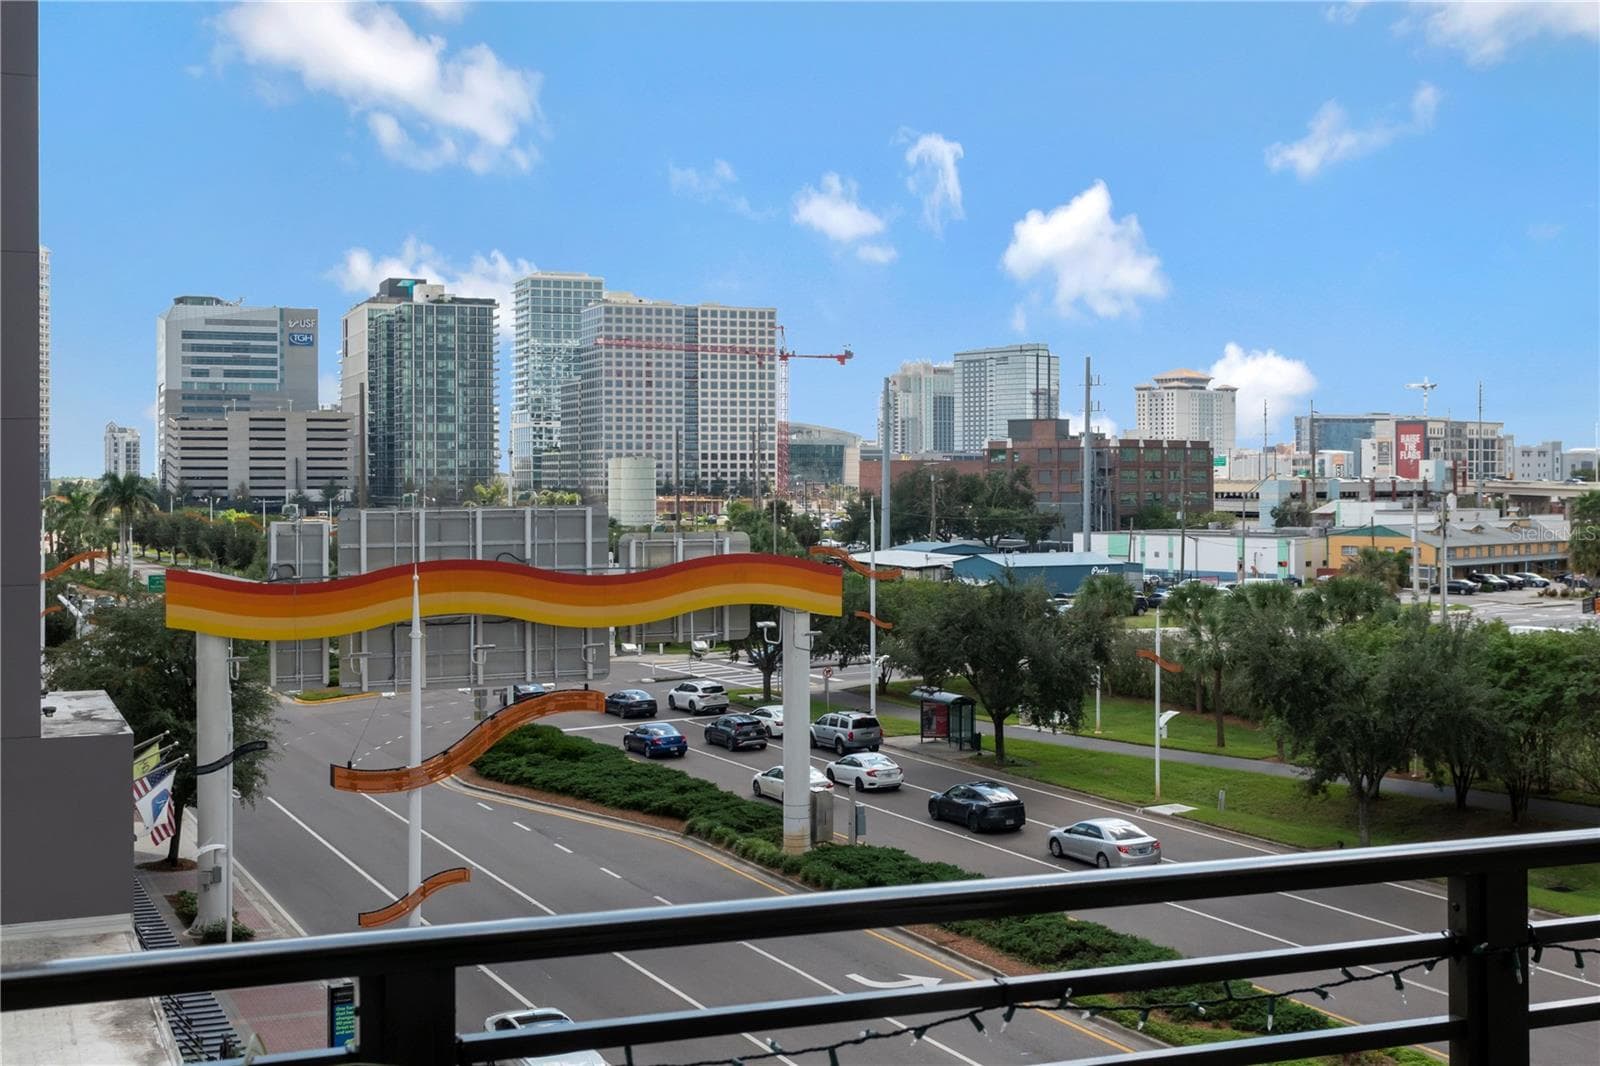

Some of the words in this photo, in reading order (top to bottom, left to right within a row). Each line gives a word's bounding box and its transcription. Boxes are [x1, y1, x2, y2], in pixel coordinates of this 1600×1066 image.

[300, 319, 316, 328] USF
[292, 334, 313, 342] TGH
[1400, 434, 1421, 443] RAISE
[1404, 442, 1417, 451] THE
[1400, 450, 1421, 460] FLAGS
